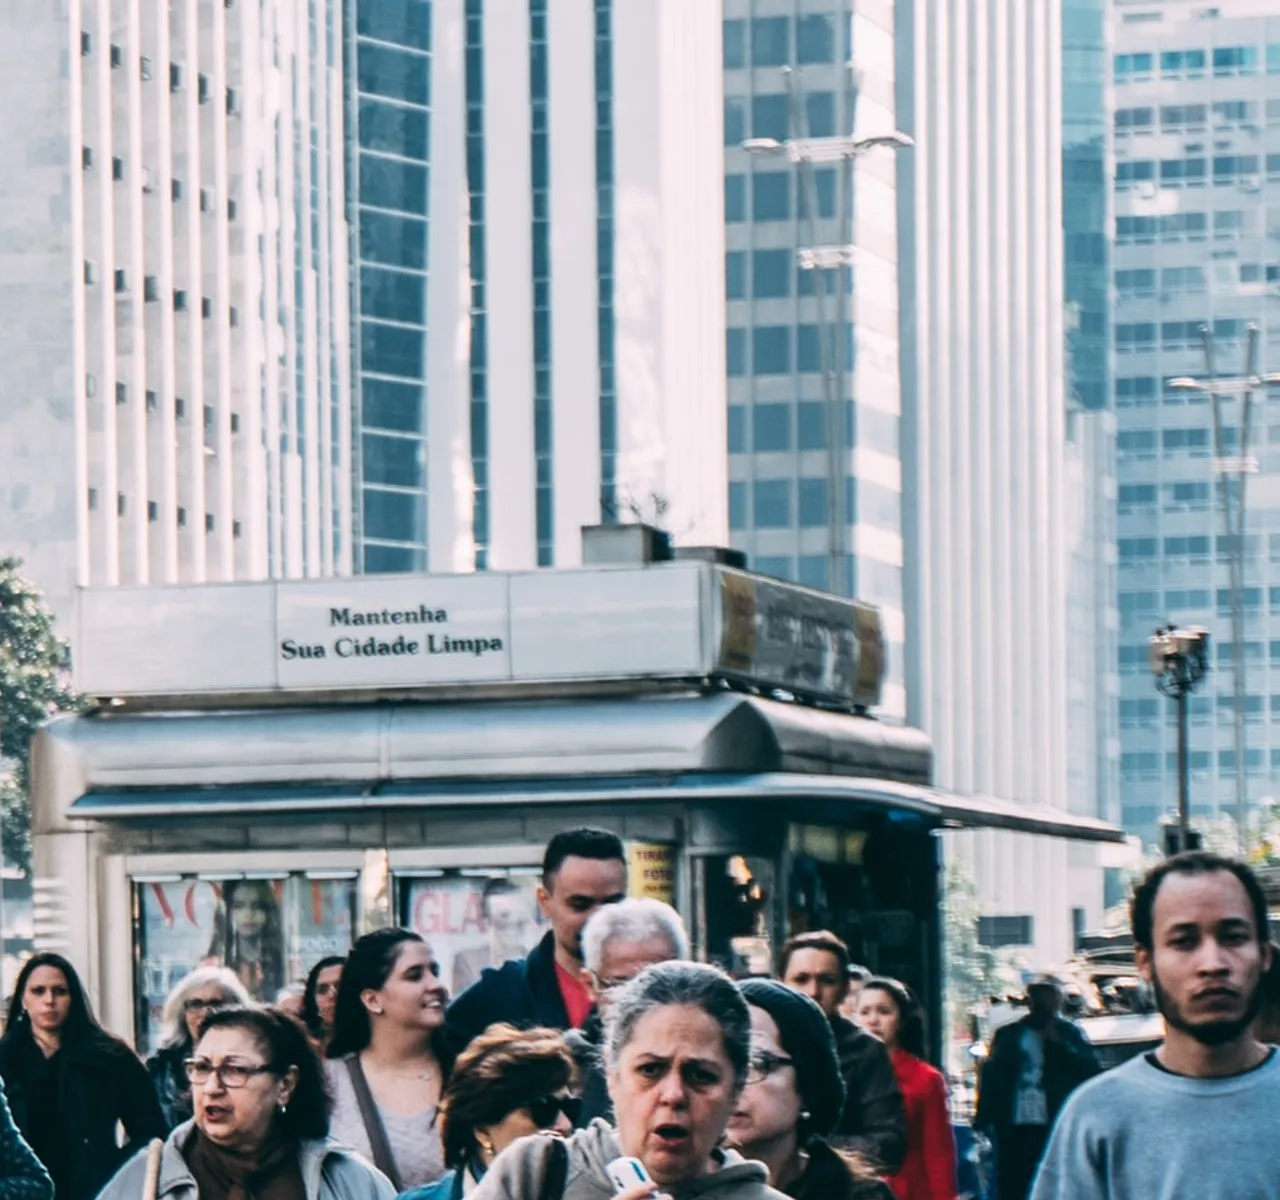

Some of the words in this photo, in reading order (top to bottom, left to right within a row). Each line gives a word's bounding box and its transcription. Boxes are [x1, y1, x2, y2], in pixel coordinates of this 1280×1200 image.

[329, 604, 448, 627] Mantenha
[281, 639, 326, 660] Sua
[334, 634, 420, 658] Cidade
[427, 633, 504, 657] Limpa
